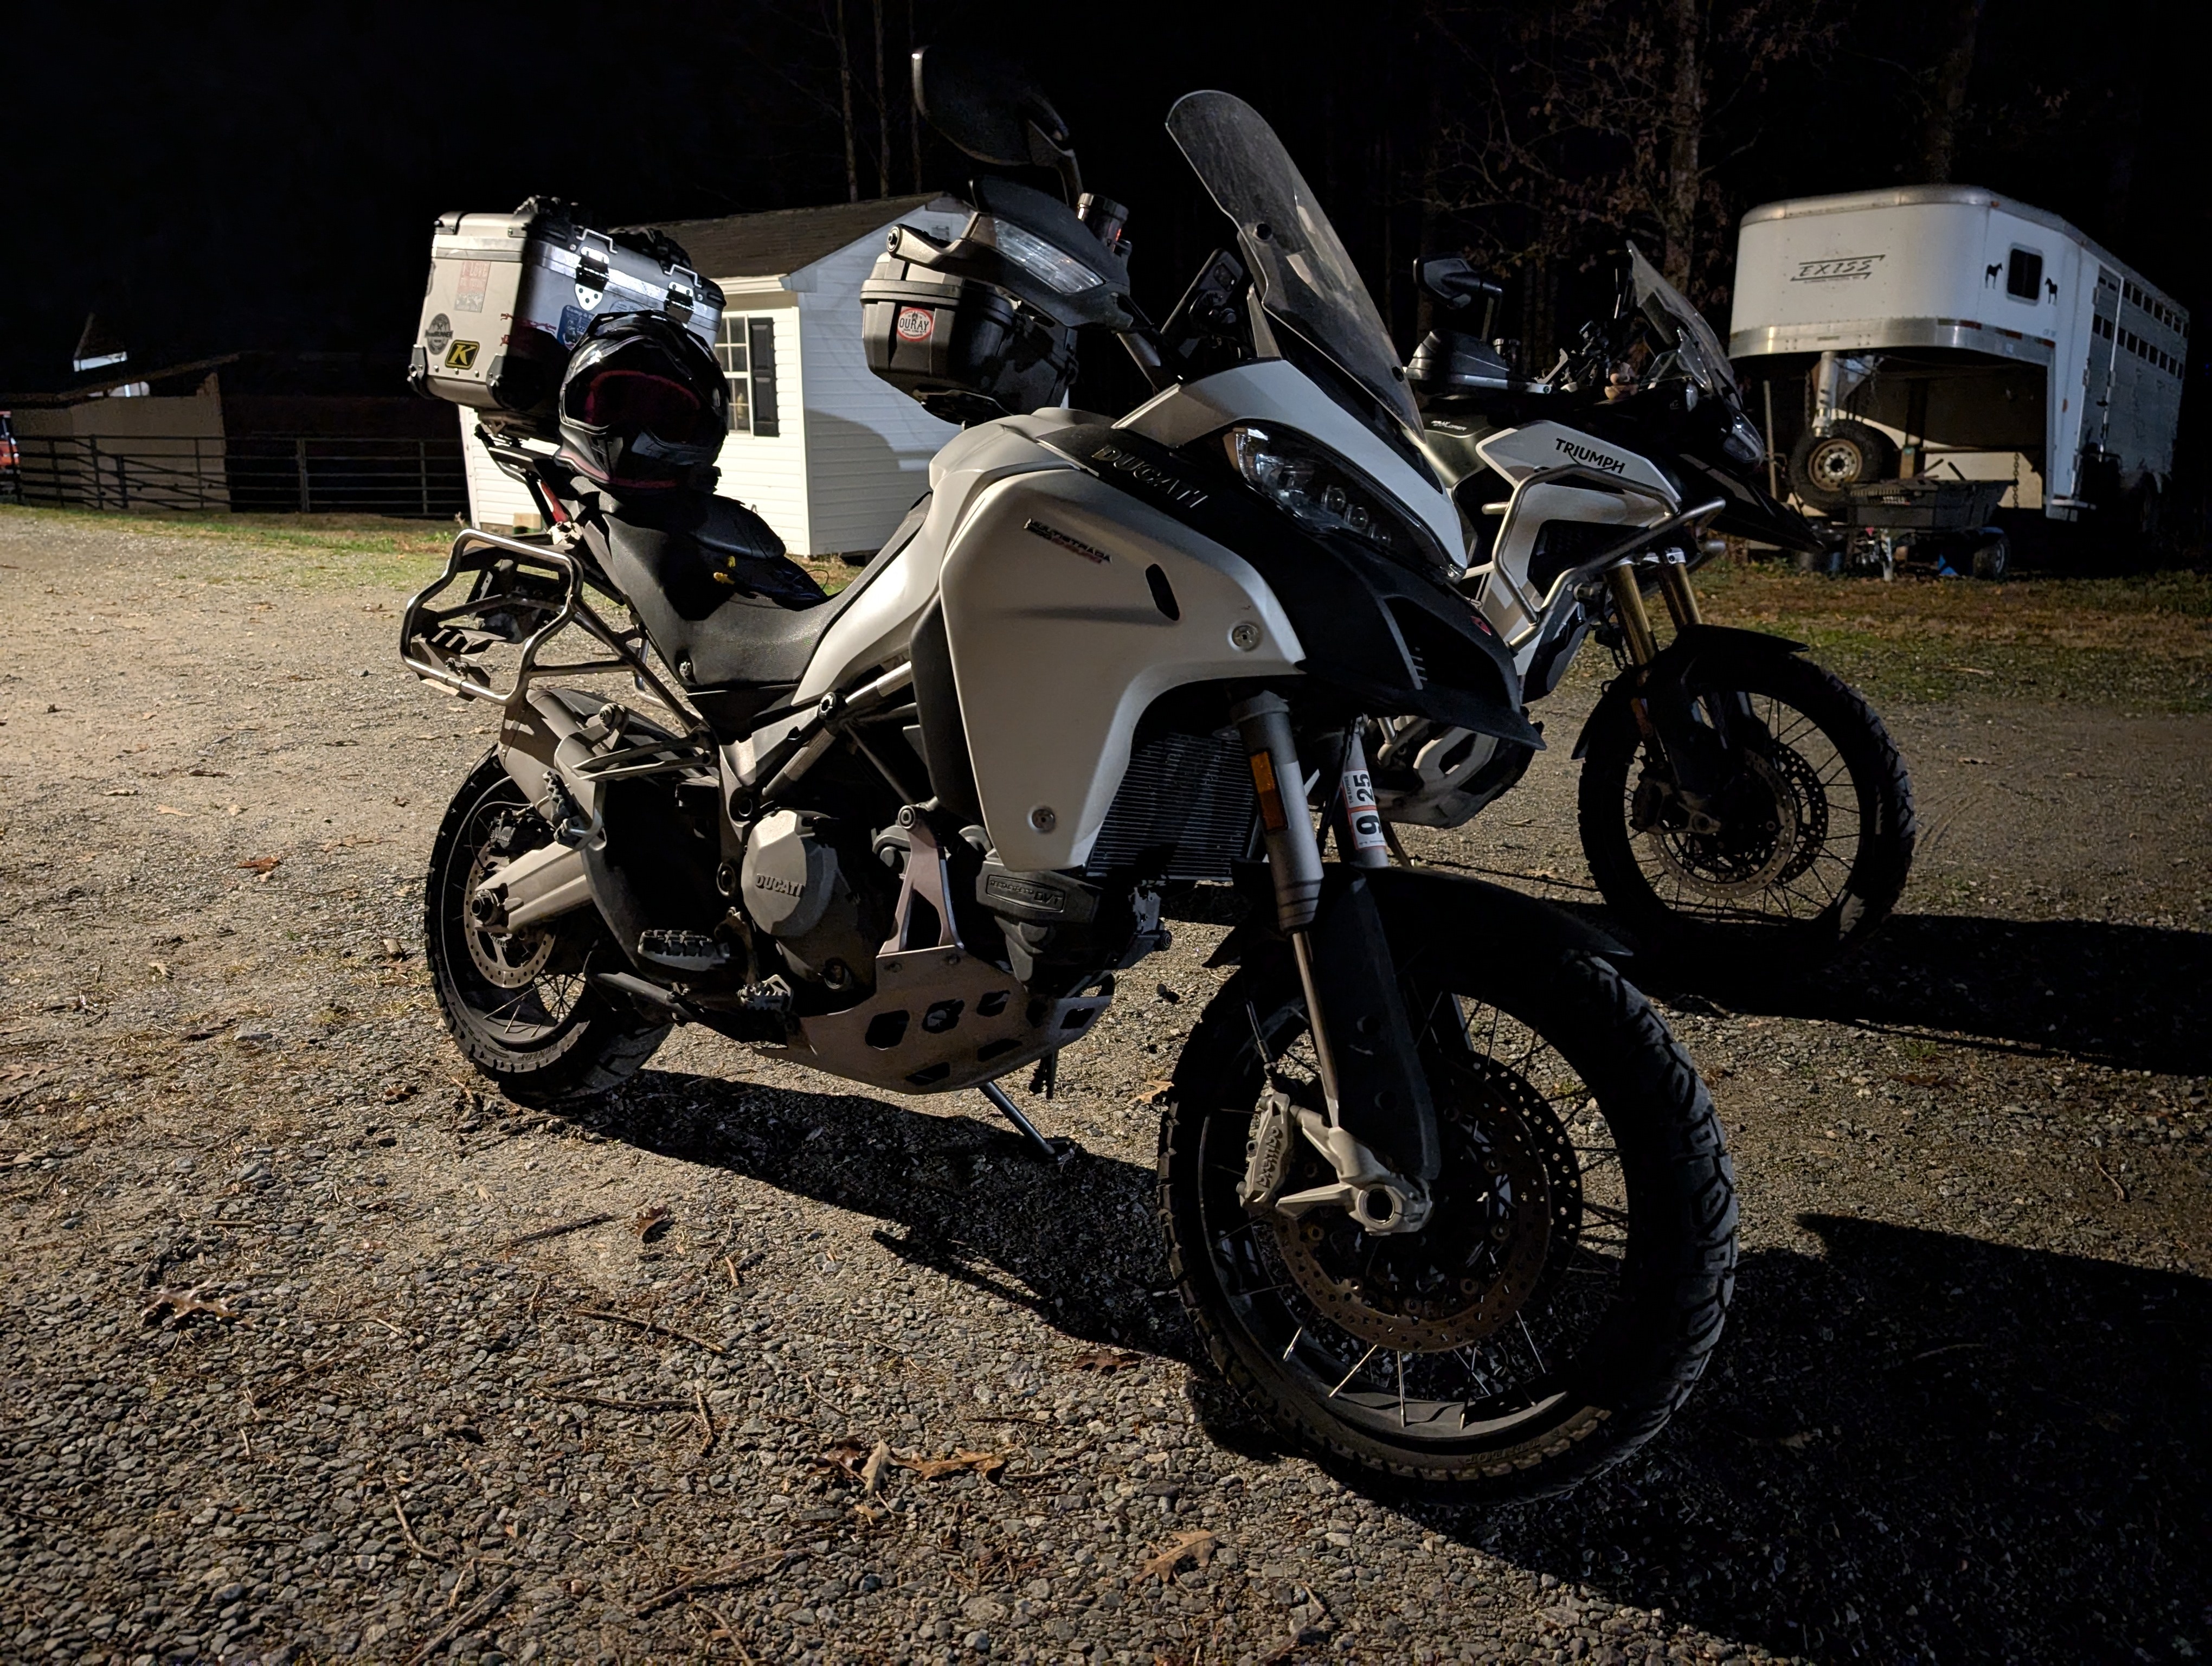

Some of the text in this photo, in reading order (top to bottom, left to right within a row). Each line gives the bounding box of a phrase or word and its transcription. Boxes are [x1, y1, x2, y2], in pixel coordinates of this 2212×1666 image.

[1799, 260, 1872, 277] EXISS
[566, 306, 582, 316] Camp
[899, 317, 929, 331] OURAY
[448, 344, 477, 365] K
[1555, 438, 1625, 474] TRIUMPH
[1091, 445, 1208, 509] DUCATI
[1353, 773, 1374, 802] 25
[755, 874, 805, 898] DUCATI
[1255, 1125, 1283, 1188] brembo
